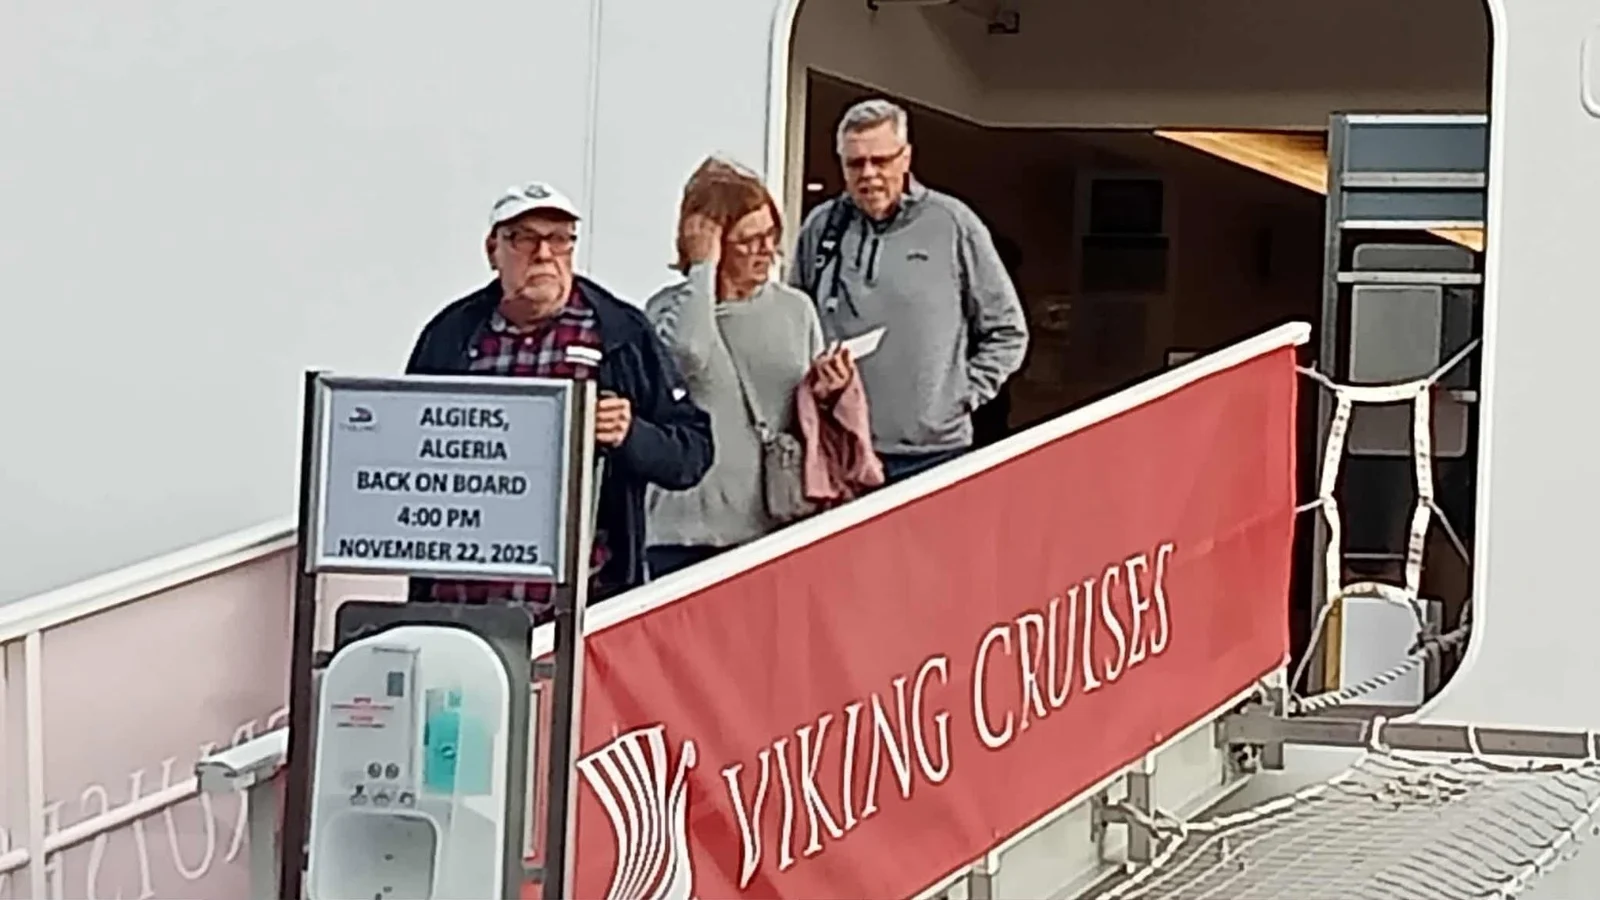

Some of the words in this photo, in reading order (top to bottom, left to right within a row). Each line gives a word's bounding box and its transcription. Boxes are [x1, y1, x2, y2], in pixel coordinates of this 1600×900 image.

[420, 407, 510, 431] ALGIERS,
[419, 439, 508, 460] ALGERIA
[357, 471, 411, 491] BACK
[415, 474, 448, 493] ON
[453, 475, 527, 495] BOARD
[397, 507, 442, 526] 4:00
[447, 509, 481, 528] PM
[339, 539, 451, 561] NOVEMBER
[456, 543, 486, 563] 22,
[491, 544, 538, 563] 2025
[721, 655, 950, 890] VIKING
[973, 542, 1175, 749] CRUISES
